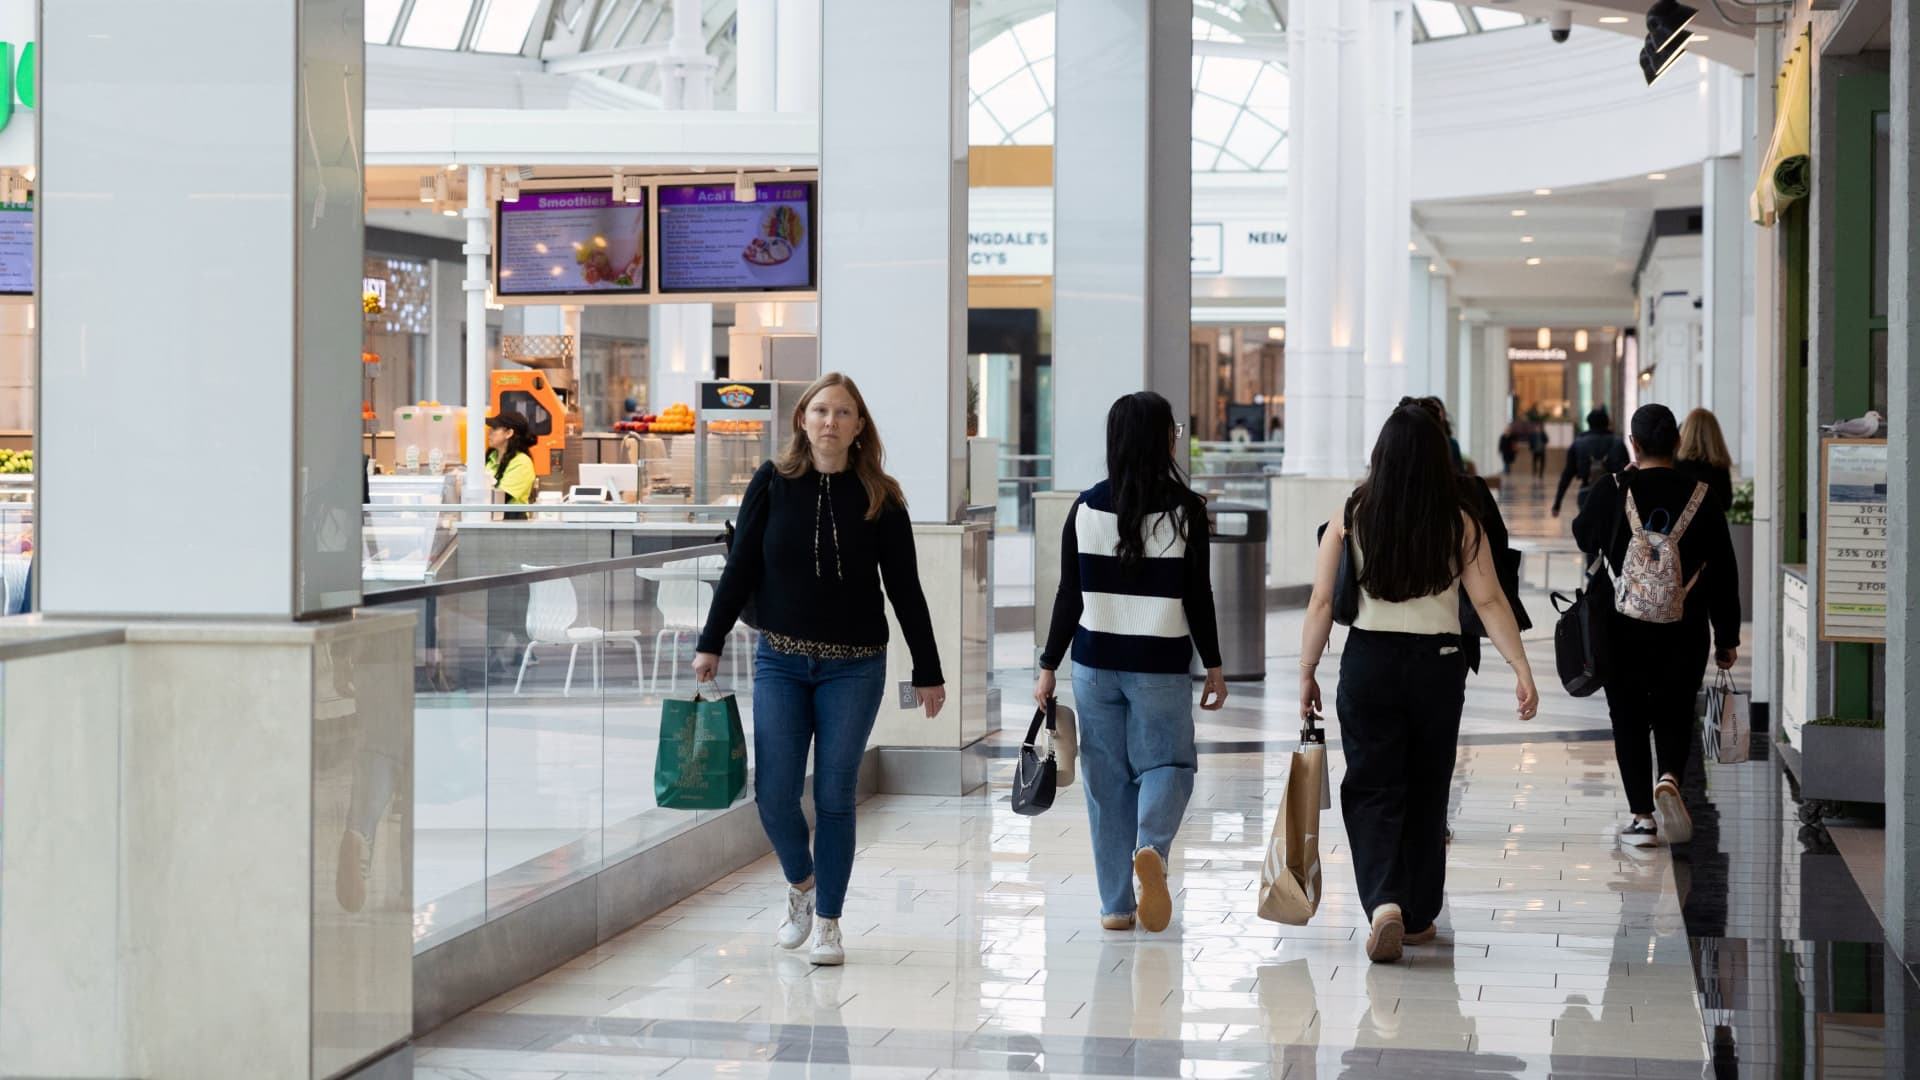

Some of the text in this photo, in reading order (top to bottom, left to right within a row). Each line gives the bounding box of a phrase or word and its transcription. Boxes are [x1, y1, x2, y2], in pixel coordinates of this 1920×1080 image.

[538, 196, 606, 209] Smoothies
[968, 251, 1008, 265] CY'S
[1854, 516, 1872, 525] ALL
[1862, 528, 1870, 536] &
[1837, 548, 1886, 559] 25% OFF
[1857, 582, 1887, 591] 2 FOR
